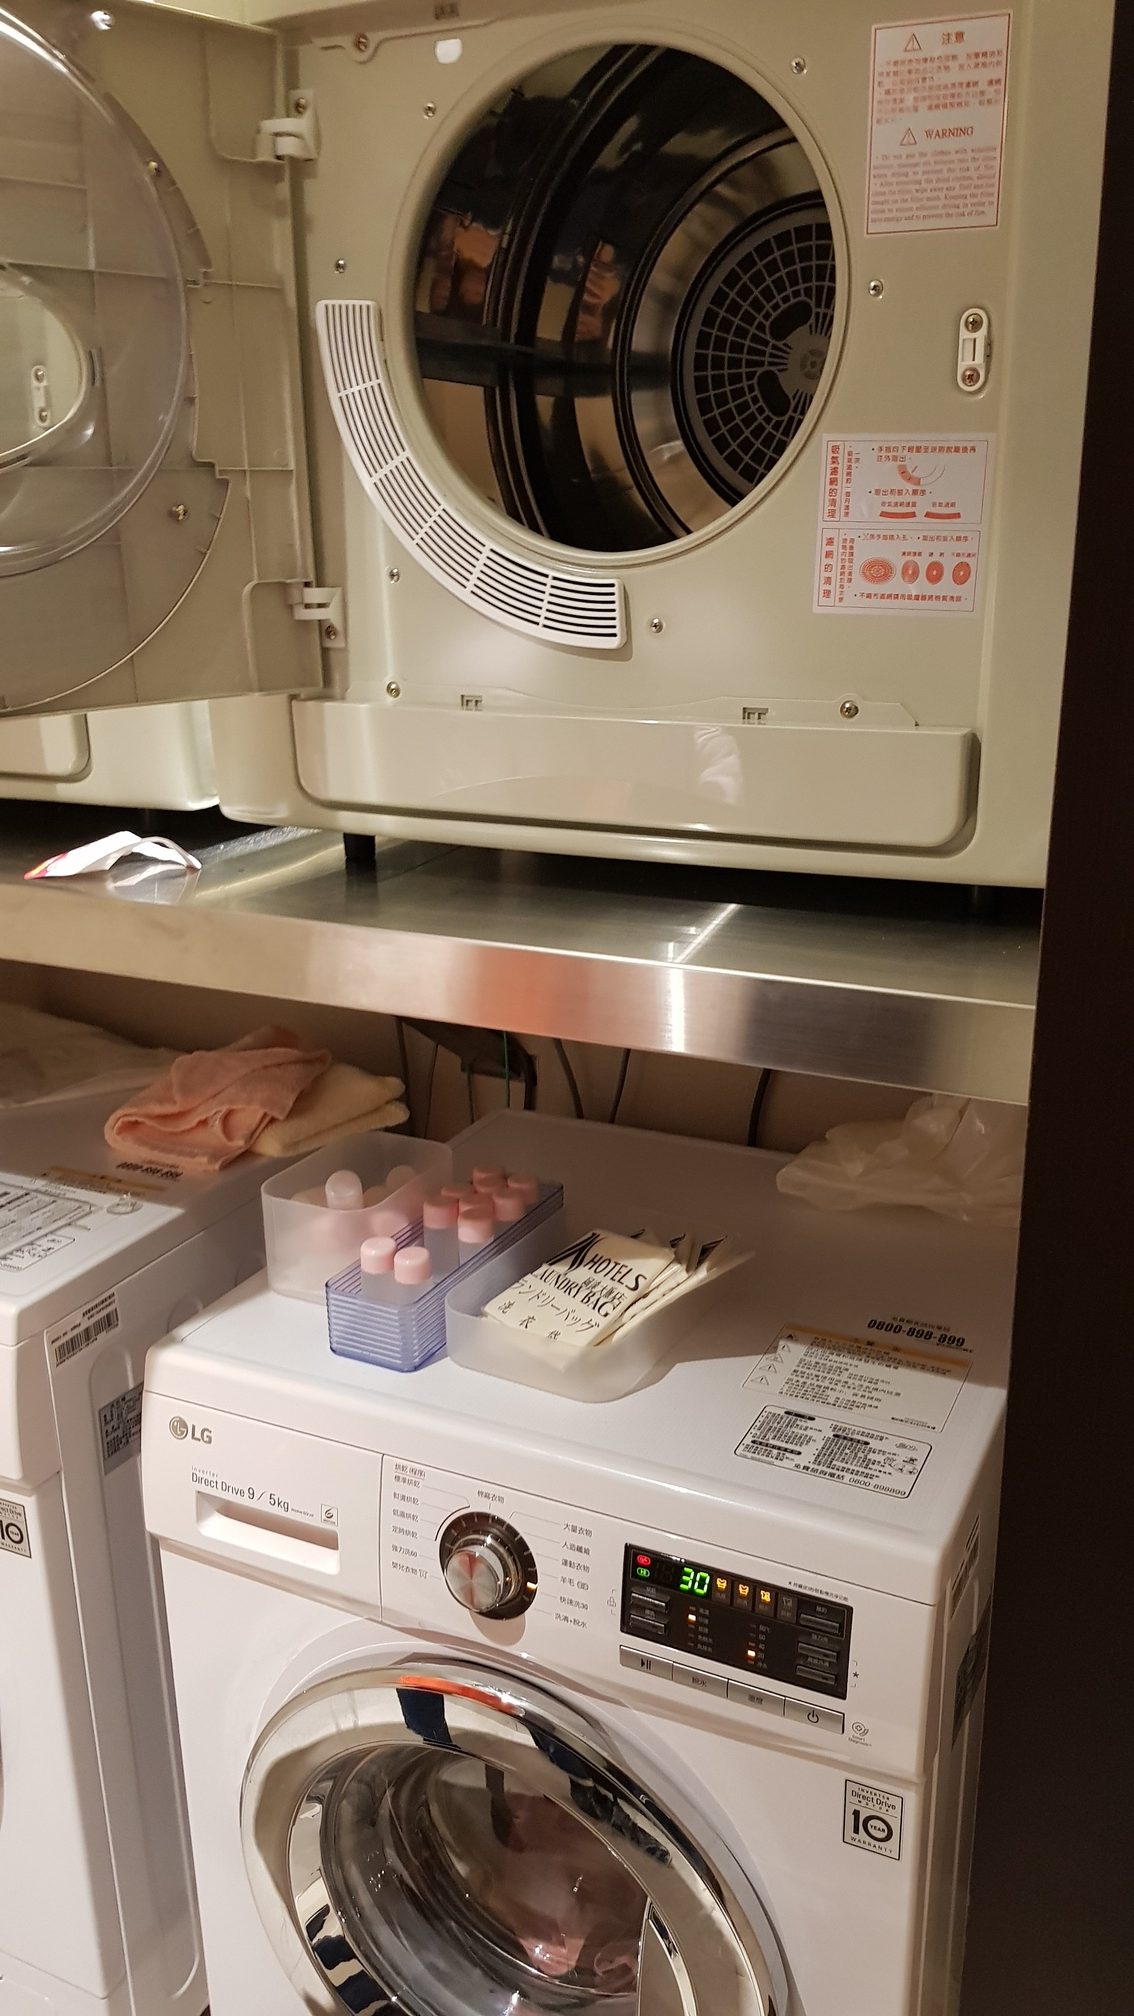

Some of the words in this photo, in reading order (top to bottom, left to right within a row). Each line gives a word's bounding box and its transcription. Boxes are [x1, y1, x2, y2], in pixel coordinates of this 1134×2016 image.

[942, 31, 965, 45] 注意
[924, 126, 974, 140] WARNING
[583, 1253, 648, 1292] HOTELS
[511, 1279, 600, 1333] ランドリーバッグ
[580, 1289, 611, 1318] BAG
[867, 1319, 966, 1348] 0800-898-899
[191, 1424, 212, 1444] LG
[191, 1472, 219, 1490] Direct
[221, 1481, 245, 1498] Drive
[679, 1567, 711, 1595] 30
[851, 1790, 875, 1805] Direct
[876, 1796, 896, 1810] Drive
[858, 1787, 890, 1801] INVERTER
[858, 1800, 889, 1812] MOTOR
[852, 1808, 894, 1843] 10
[870, 1824, 886, 1833] YEAR
[850, 1836, 893, 1854] WARRANTY
